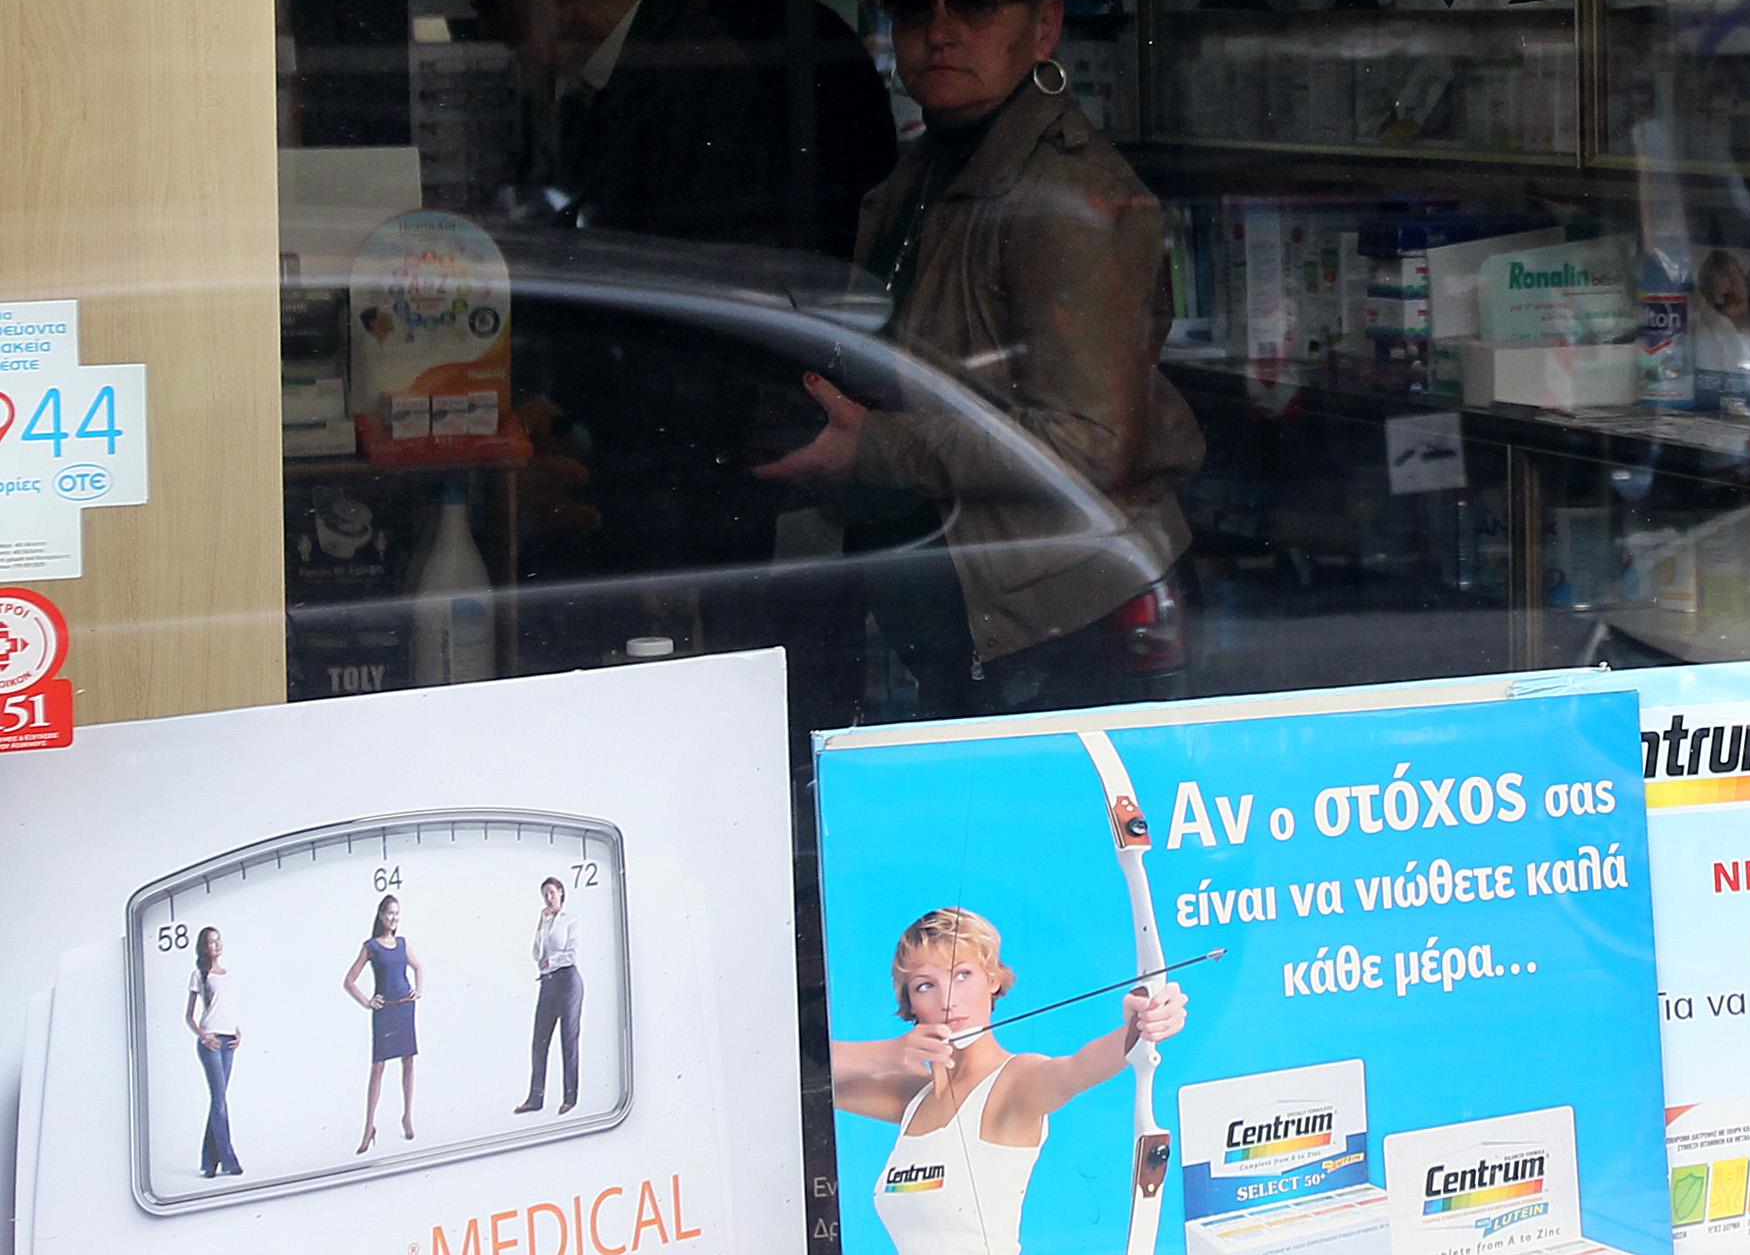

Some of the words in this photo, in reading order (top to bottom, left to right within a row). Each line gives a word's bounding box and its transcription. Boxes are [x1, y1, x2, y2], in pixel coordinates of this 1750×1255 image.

[0, 357, 40, 372] έστε
[0, 693, 51, 734] 51
[1166, 781, 1253, 851] Αν
[1268, 805, 1296, 838] ο
[1314, 762, 1527, 839] στόχος
[1544, 777, 1617, 820] σας
[373, 866, 404, 893] 64
[571, 864, 600, 888] 72
[1177, 878, 1277, 930] είναι
[1289, 878, 1345, 918] να
[1355, 860, 1516, 913] νιώθετε
[1526, 843, 1629, 897] καλά
[157, 924, 190, 952] 58
[1283, 944, 1385, 1000] κάθε
[1394, 938, 1538, 998] μέρα...
[1706, 991, 1747, 1018] να
[1226, 1112, 1333, 1149] Centrum
[886, 1164, 945, 1184] Centrum
[1425, 1156, 1545, 1197] Centrum
[1236, 1176, 1301, 1202] SELECT
[431, 1173, 702, 1255] MEDICAL
[1493, 1204, 1545, 1231] LUTEIN
[1536, 1226, 1562, 1241] Zinc
